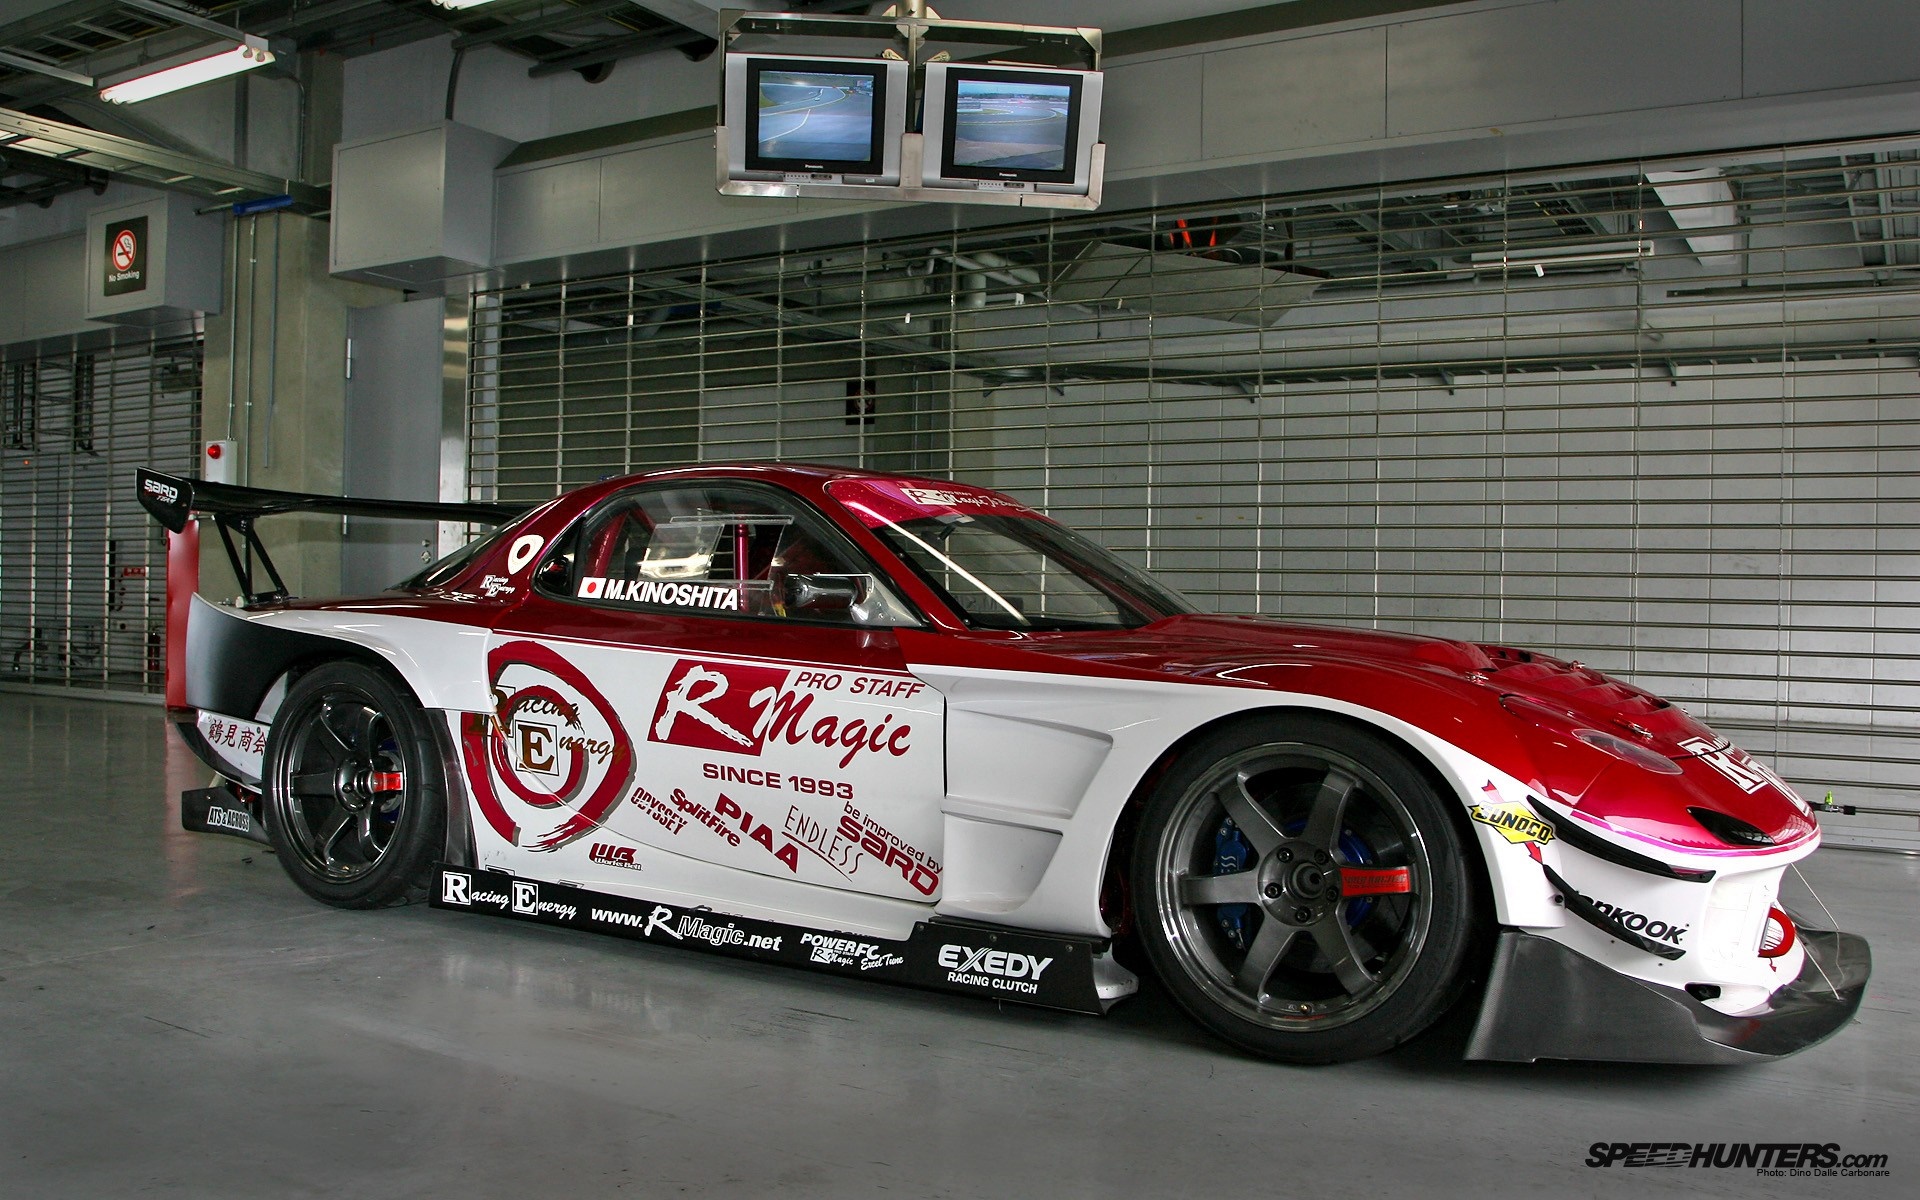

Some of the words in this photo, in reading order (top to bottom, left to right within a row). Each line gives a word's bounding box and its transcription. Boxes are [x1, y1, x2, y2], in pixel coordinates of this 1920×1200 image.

[108, 274, 117, 283] No
[116, 271, 140, 281] Smoking
[604, 578, 739, 611] M.KINOSHITA
[793, 671, 842, 691] PRO
[850, 676, 925, 699] STAFF
[702, 763, 781, 789] SINCE
[788, 776, 854, 800] 1993
[207, 806, 223, 826] ATS
[714, 793, 800, 874] PIAA
[1475, 804, 1551, 841] SUNOCO
[784, 804, 864, 875] ENDLESS
[843, 801, 861, 820] be
[862, 814, 925, 862] improved
[926, 856, 943, 874] by
[444, 872, 510, 909] Racing
[512, 882, 577, 920] Energy
[938, 944, 1054, 980] EXEDY
[947, 972, 989, 987] RACING
[992, 978, 1038, 994] CLUTCH
